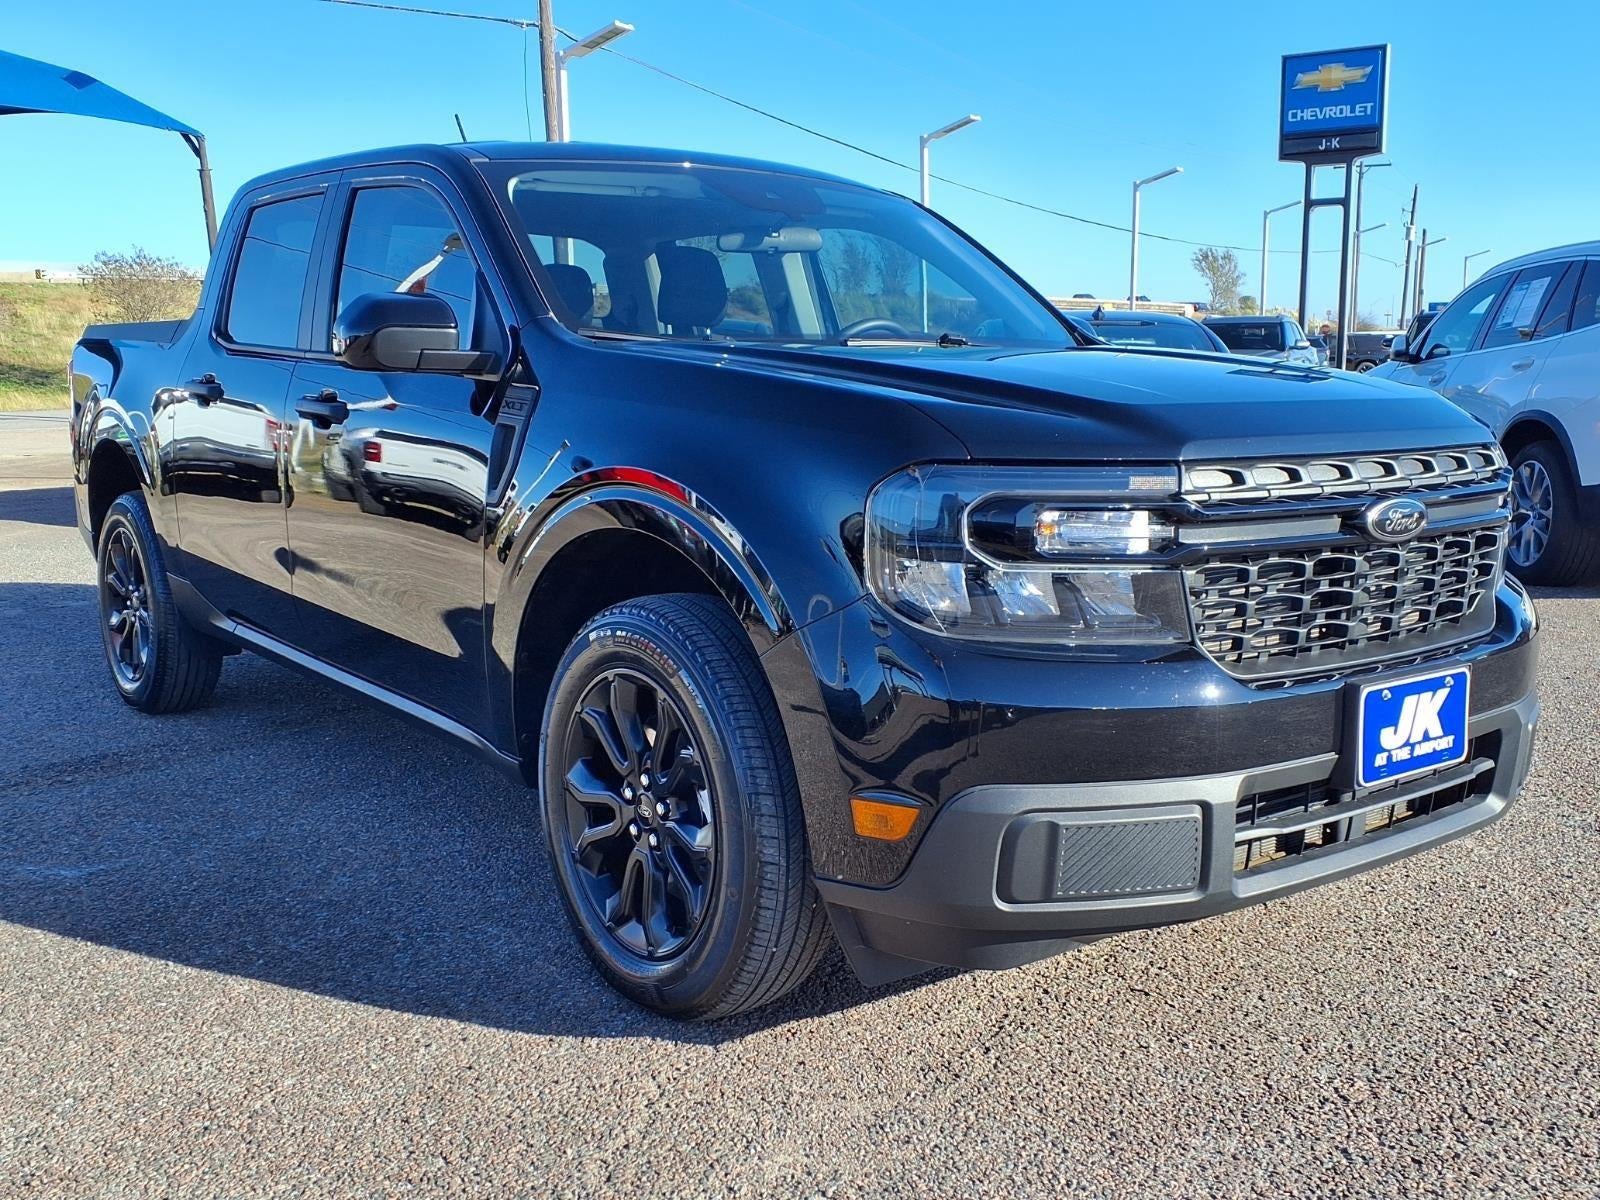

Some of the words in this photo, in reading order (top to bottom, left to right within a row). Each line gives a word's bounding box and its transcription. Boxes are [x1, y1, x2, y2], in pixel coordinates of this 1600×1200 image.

[1288, 102, 1374, 121] CHEVROLET
[1318, 137, 1340, 150] J-K
[502, 400, 528, 411] XLT
[1385, 507, 1420, 532] Ford
[1380, 687, 1451, 750] JK
[1374, 751, 1389, 767] AT
[1390, 746, 1412, 762] THE
[1413, 735, 1455, 757] AIRPORT
